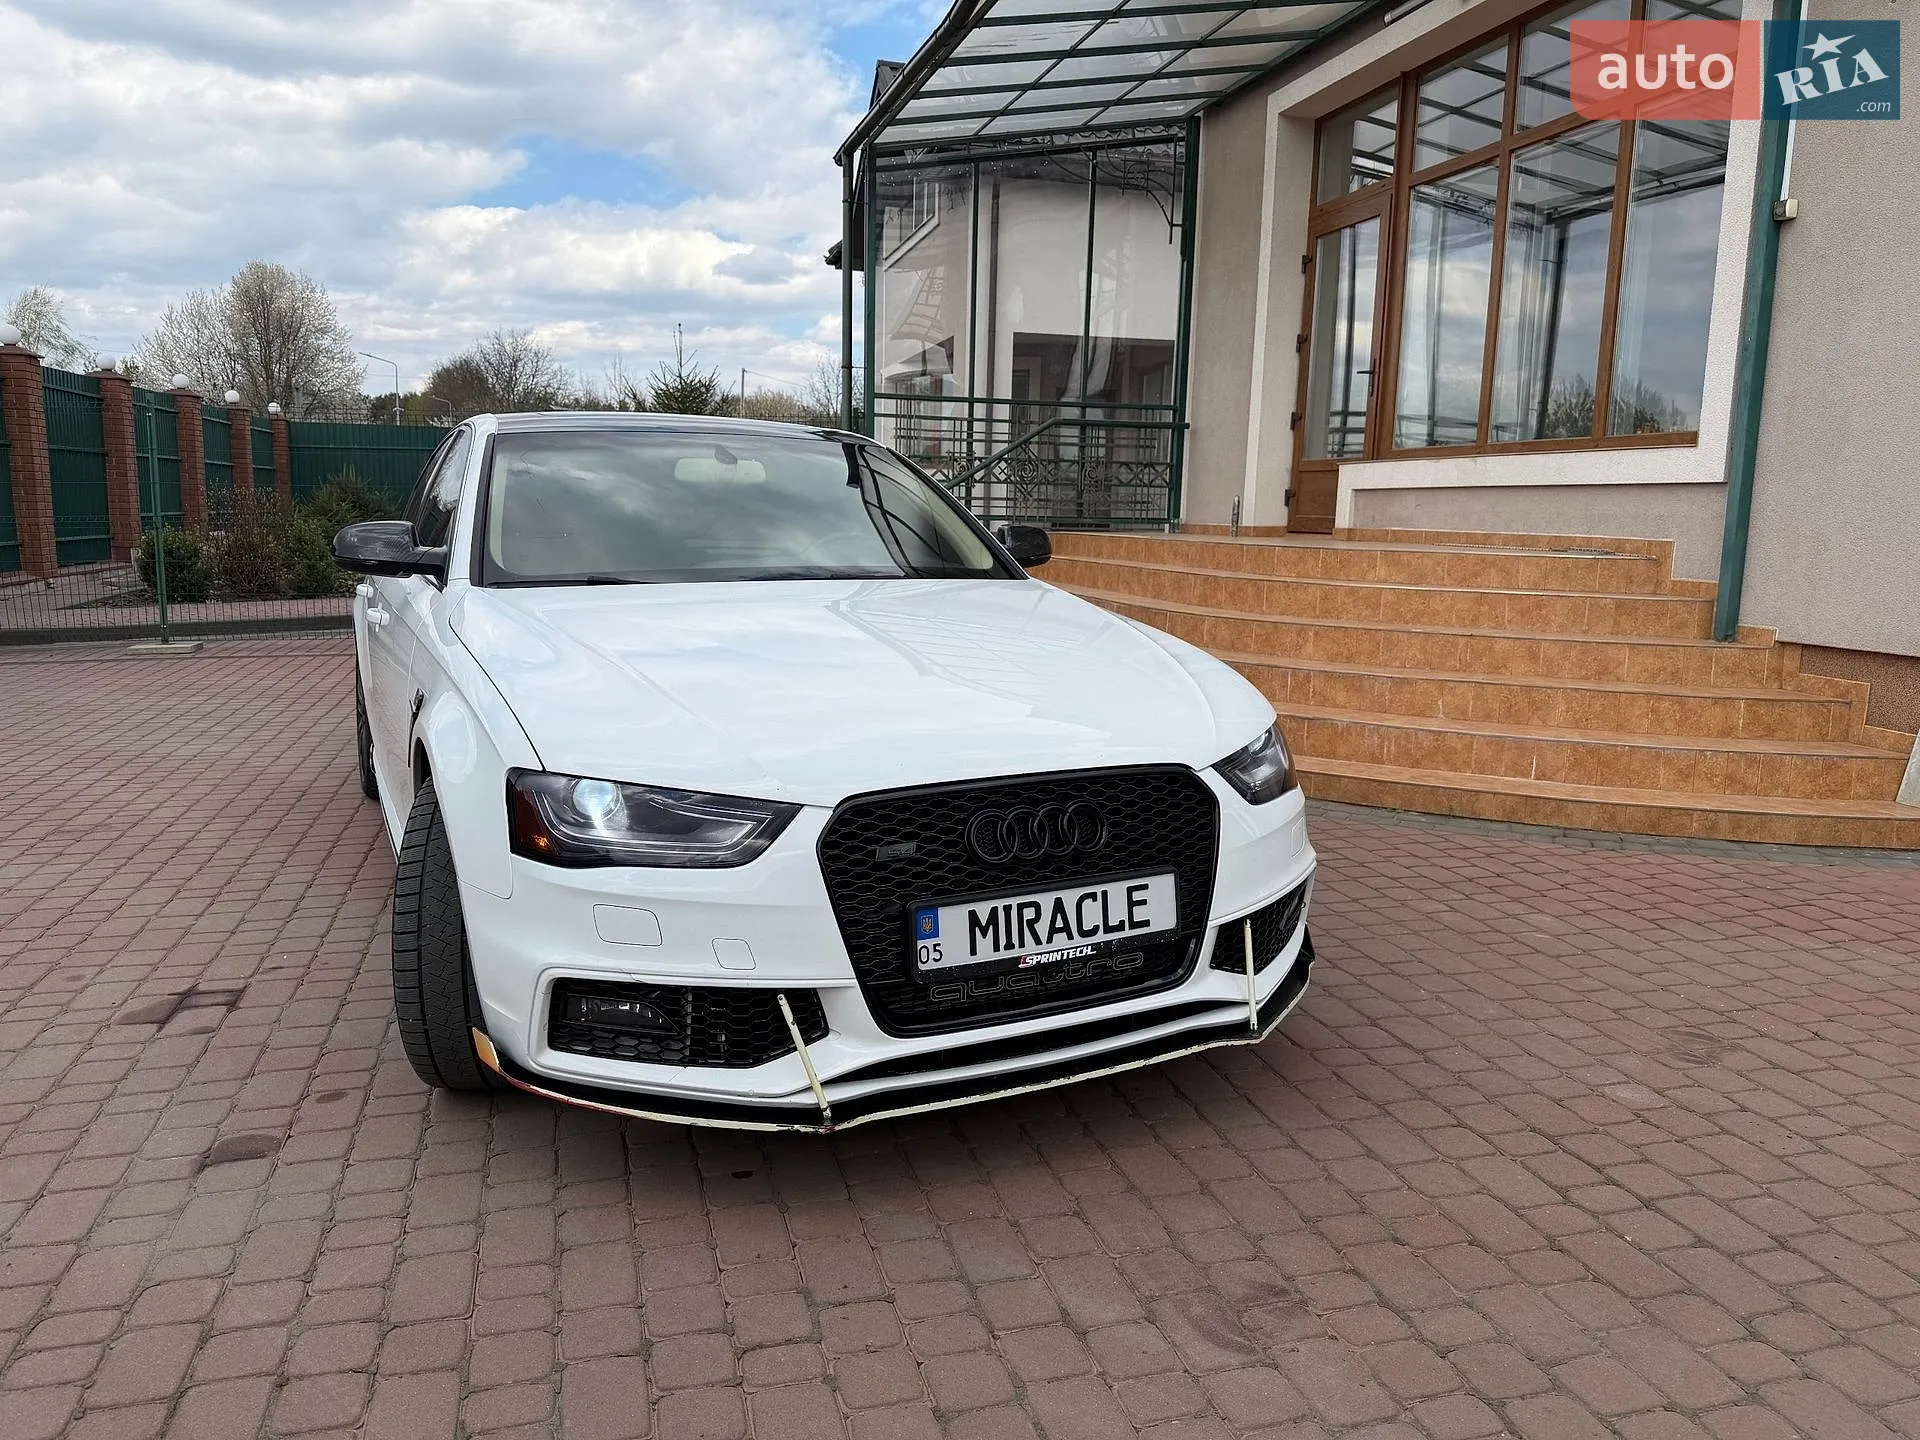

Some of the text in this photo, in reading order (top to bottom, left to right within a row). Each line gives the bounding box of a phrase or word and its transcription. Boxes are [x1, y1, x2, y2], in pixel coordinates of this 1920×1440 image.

[968, 883, 1151, 956] MIRACLE
[918, 943, 944, 965] 05
[1018, 945, 1097, 968] SPRINTECH
[930, 951, 1144, 1002] quattro
